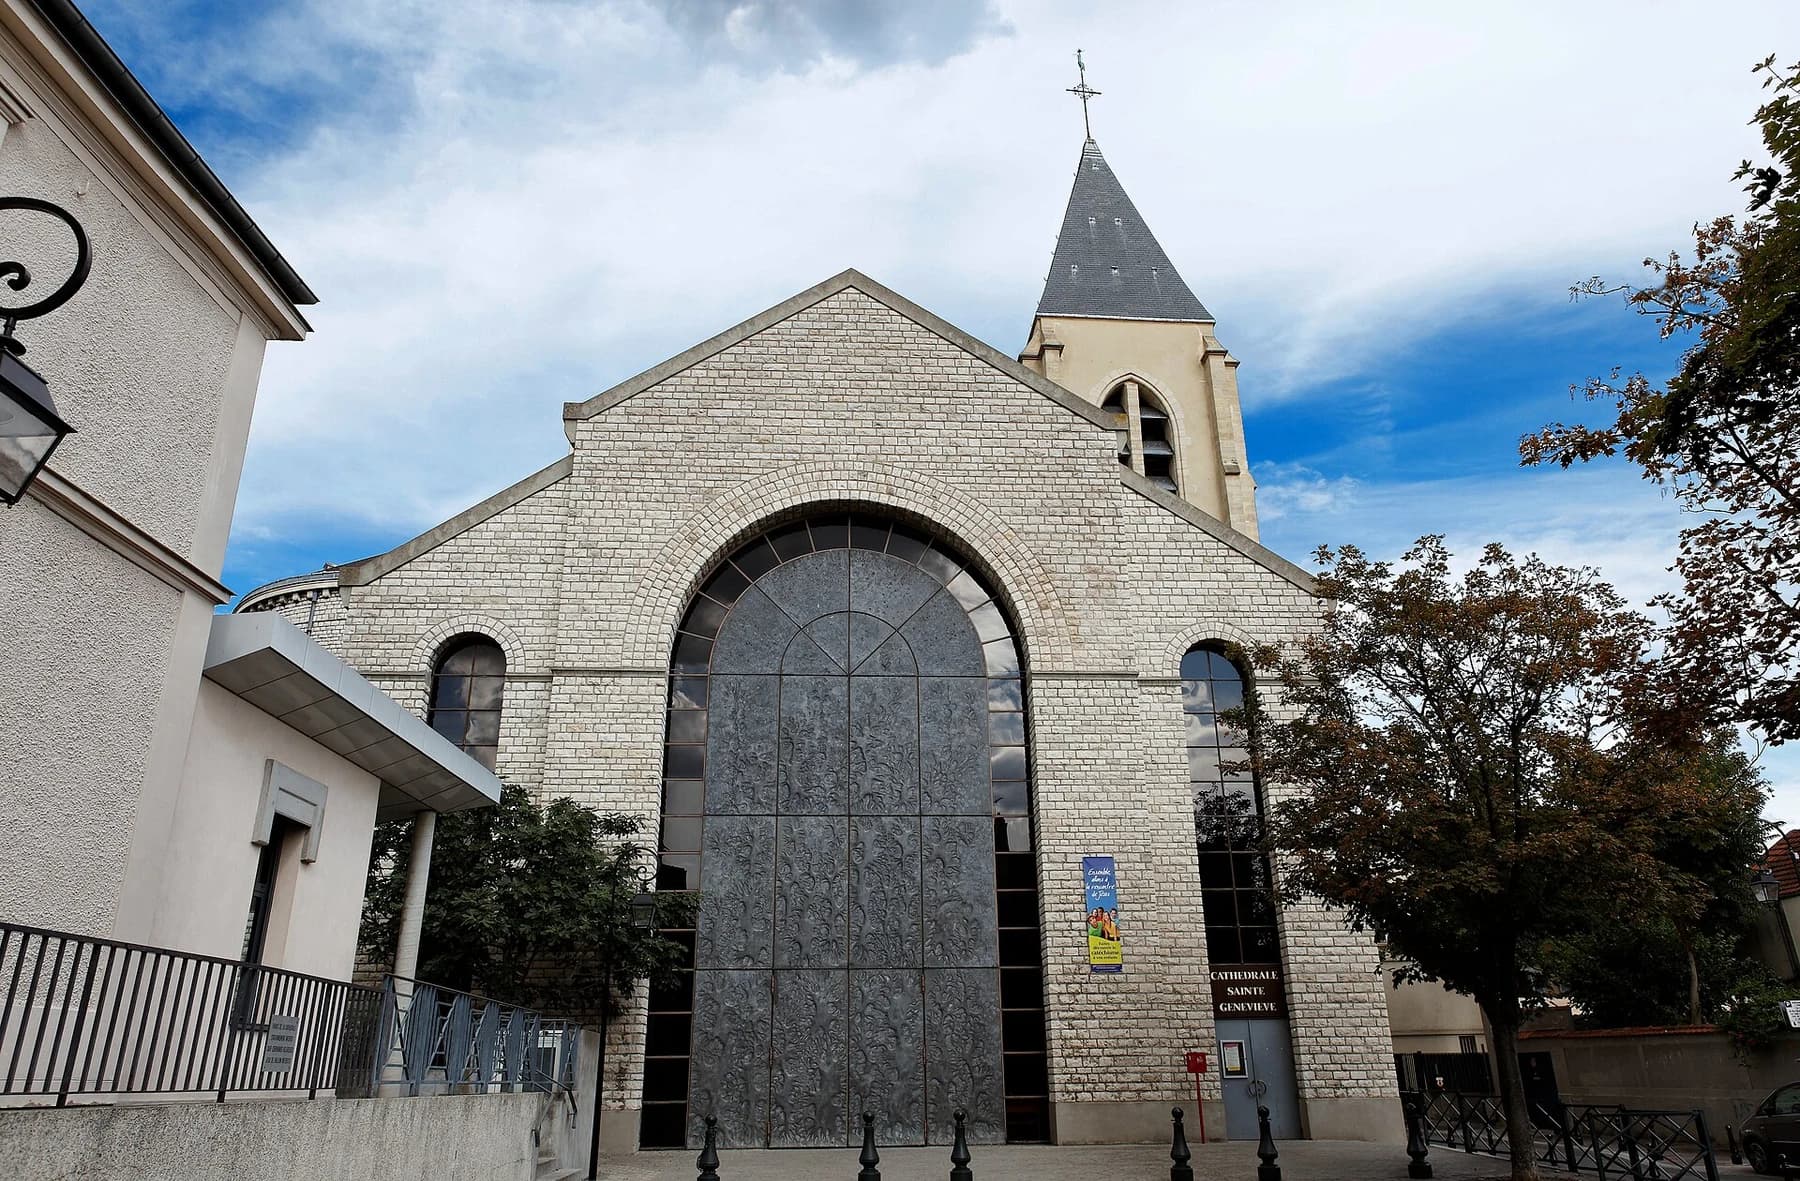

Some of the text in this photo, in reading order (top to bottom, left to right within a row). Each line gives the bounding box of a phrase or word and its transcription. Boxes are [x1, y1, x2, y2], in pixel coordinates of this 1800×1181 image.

[1210, 971, 1279, 980] CATHEDRALE
[1227, 986, 1266, 996] SAINTE
[1219, 1002, 1277, 1012] GENEVIEVE
